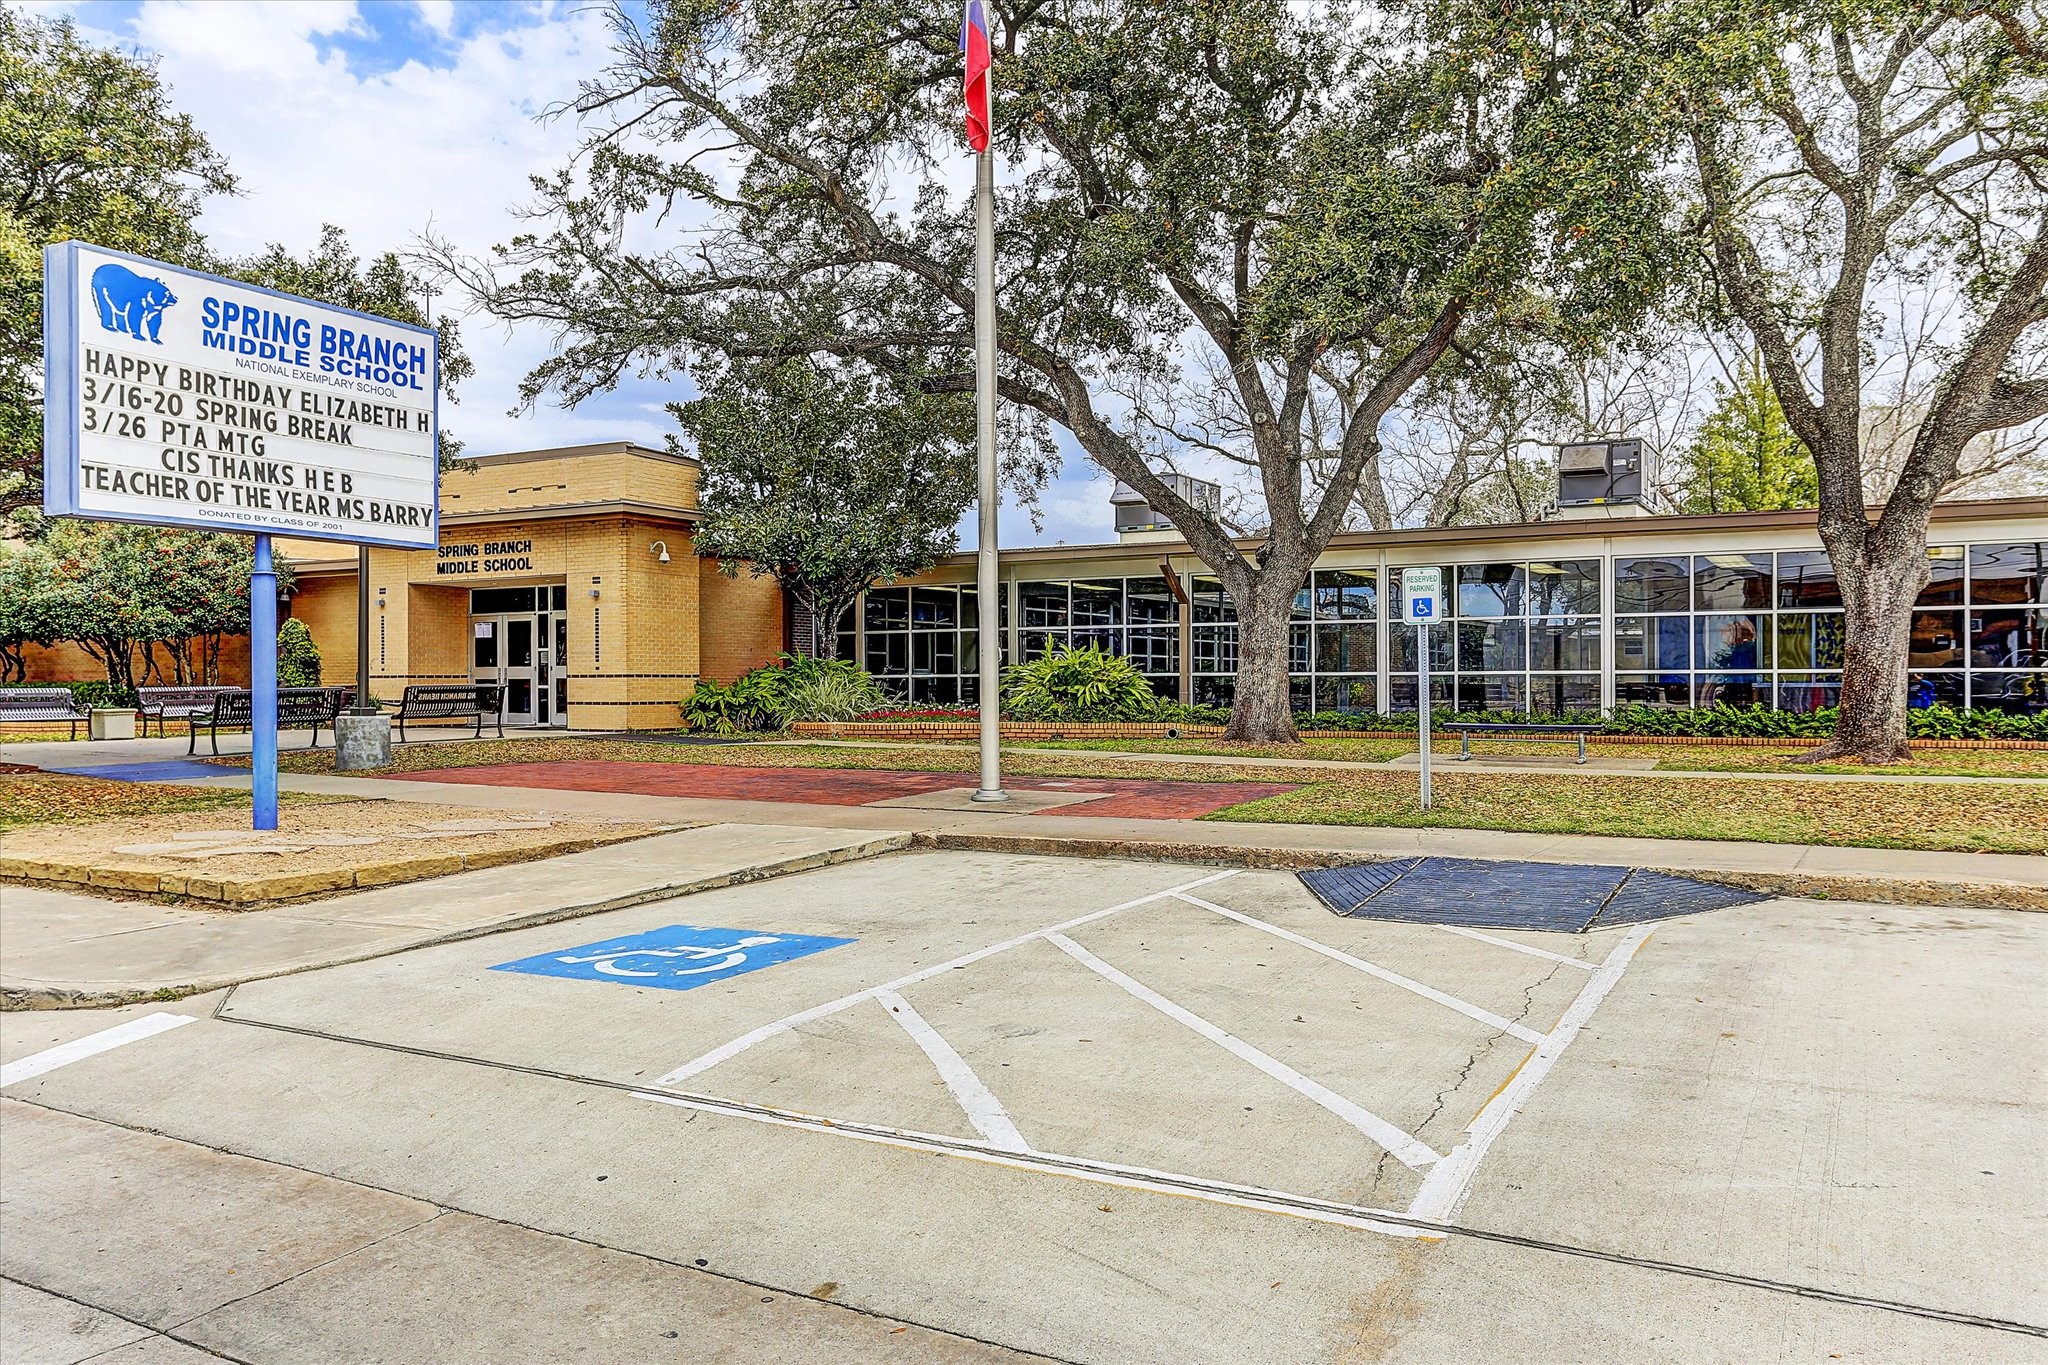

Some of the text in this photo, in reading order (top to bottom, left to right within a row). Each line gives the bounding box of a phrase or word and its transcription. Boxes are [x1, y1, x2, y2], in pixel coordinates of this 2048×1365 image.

[201, 296, 426, 375] SPRING BRANCH
[202, 329, 424, 391] MIDDLE SCHOOL
[235, 357, 397, 399] NATIONAL EXEMPLARY SCHOOL
[83, 377, 353, 445] 3/16-20 SPRING BREAK
[86, 349, 429, 433] HAPPY BIRTHDAY ELIZABETH H
[83, 406, 265, 457] 3/26 PTA MTG
[161, 448, 200, 474] CIS
[208, 455, 294, 486] THANKS
[81, 465, 433, 527] TEACHER OF THE YEAR MS BARRY
[198, 509, 251, 521] DONATED
[270, 516, 304, 527] CLASS
[306, 520, 320, 528] OF
[322, 522, 343, 531] 2001
[437, 557, 533, 575] MIDDLE SCHOOL
[438, 540, 532, 558] SPRING BRANCH
[1406, 575, 1437, 583] RESERVED
[1409, 584, 1434, 592] PARKING
